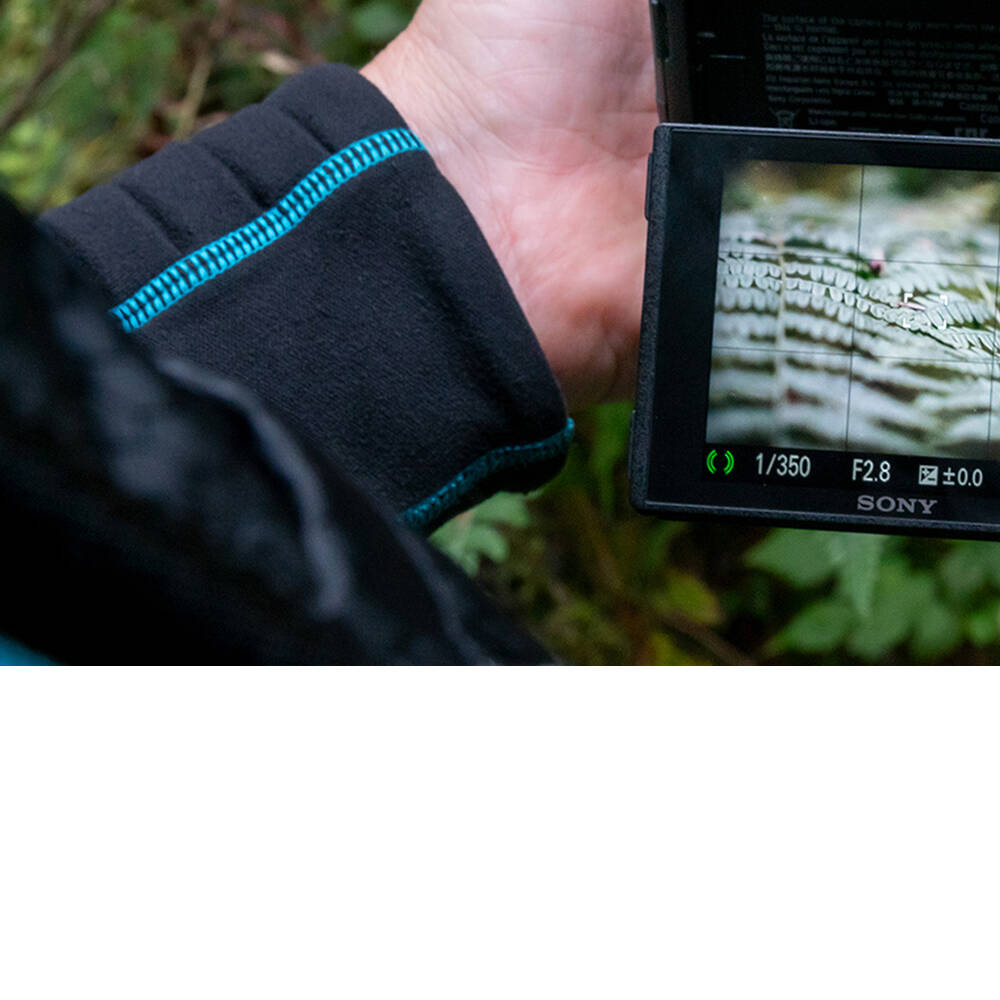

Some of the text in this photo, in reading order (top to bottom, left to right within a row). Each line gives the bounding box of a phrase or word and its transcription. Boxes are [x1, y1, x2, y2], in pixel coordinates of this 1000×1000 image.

[755, 453, 811, 478] 1/350
[852, 458, 891, 483] F2.8
[857, 495, 938, 515] SONY
